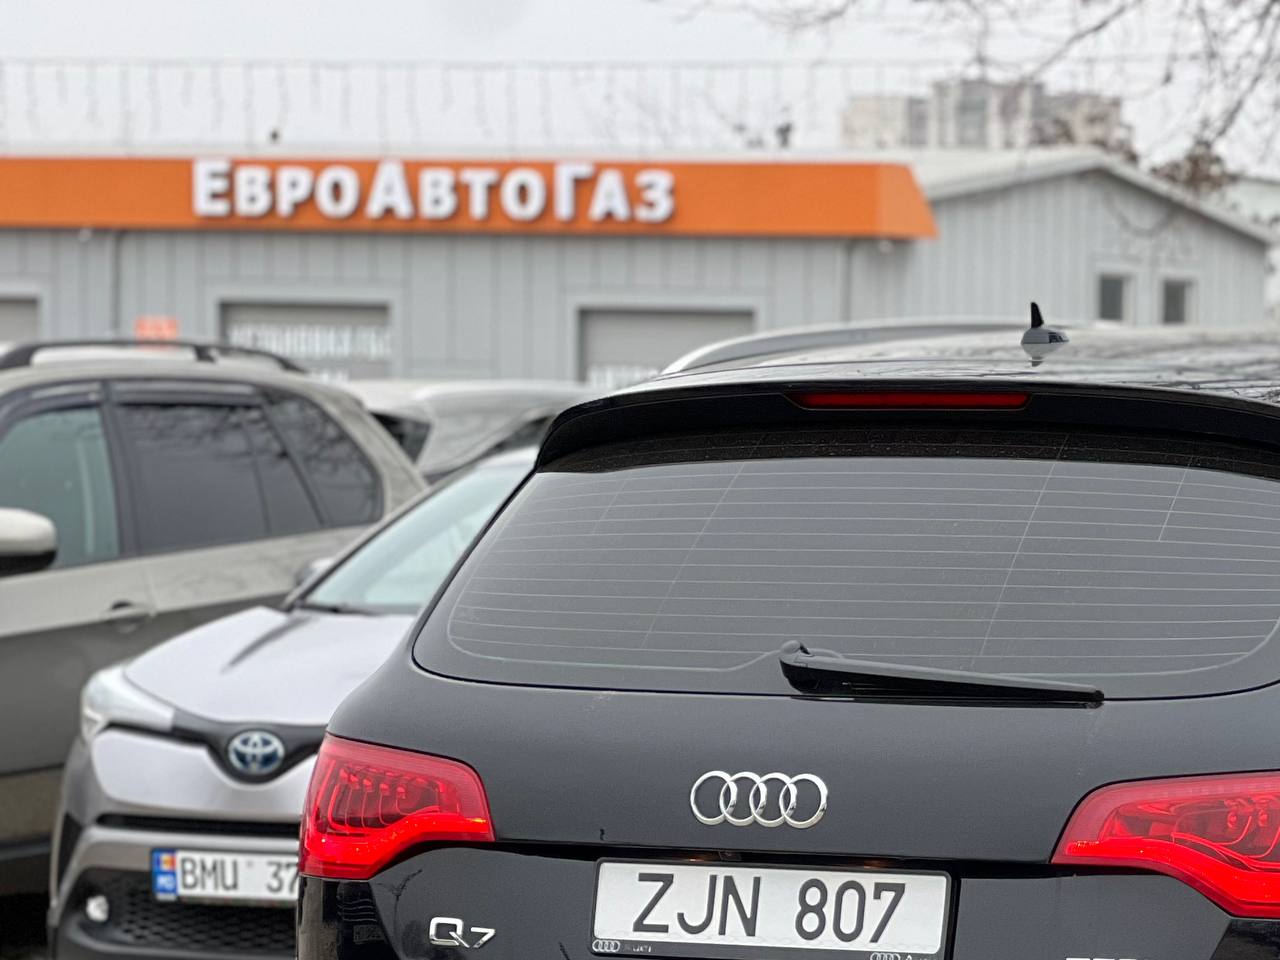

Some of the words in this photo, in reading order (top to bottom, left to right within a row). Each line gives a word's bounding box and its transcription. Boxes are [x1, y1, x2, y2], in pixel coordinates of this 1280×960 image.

[181, 857, 238, 891] BMU
[632, 872, 761, 938] ZJN
[794, 877, 907, 944] 807
[429, 916, 496, 948] Q7
